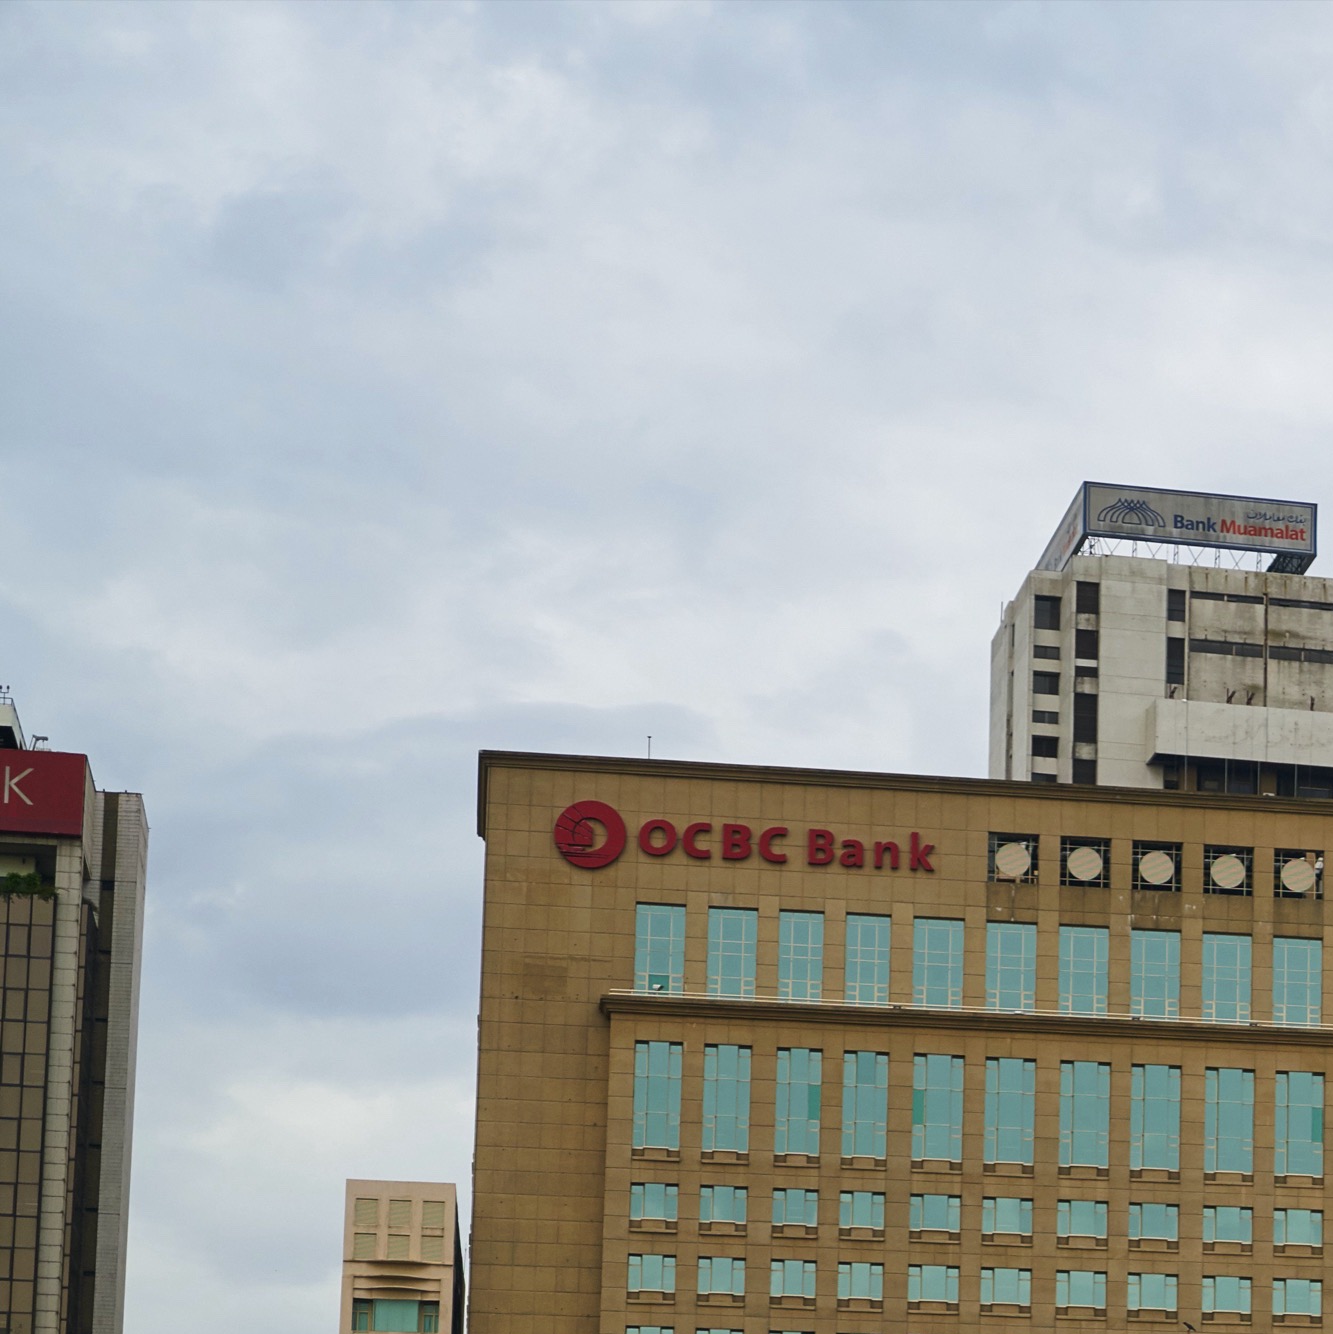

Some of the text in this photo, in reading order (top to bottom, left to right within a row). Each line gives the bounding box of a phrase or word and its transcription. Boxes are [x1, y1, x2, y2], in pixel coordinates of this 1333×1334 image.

[1173, 514, 1306, 541] Bank Muamalat
[4, 766, 34, 805] K
[639, 819, 935, 872] OCBC Bank
